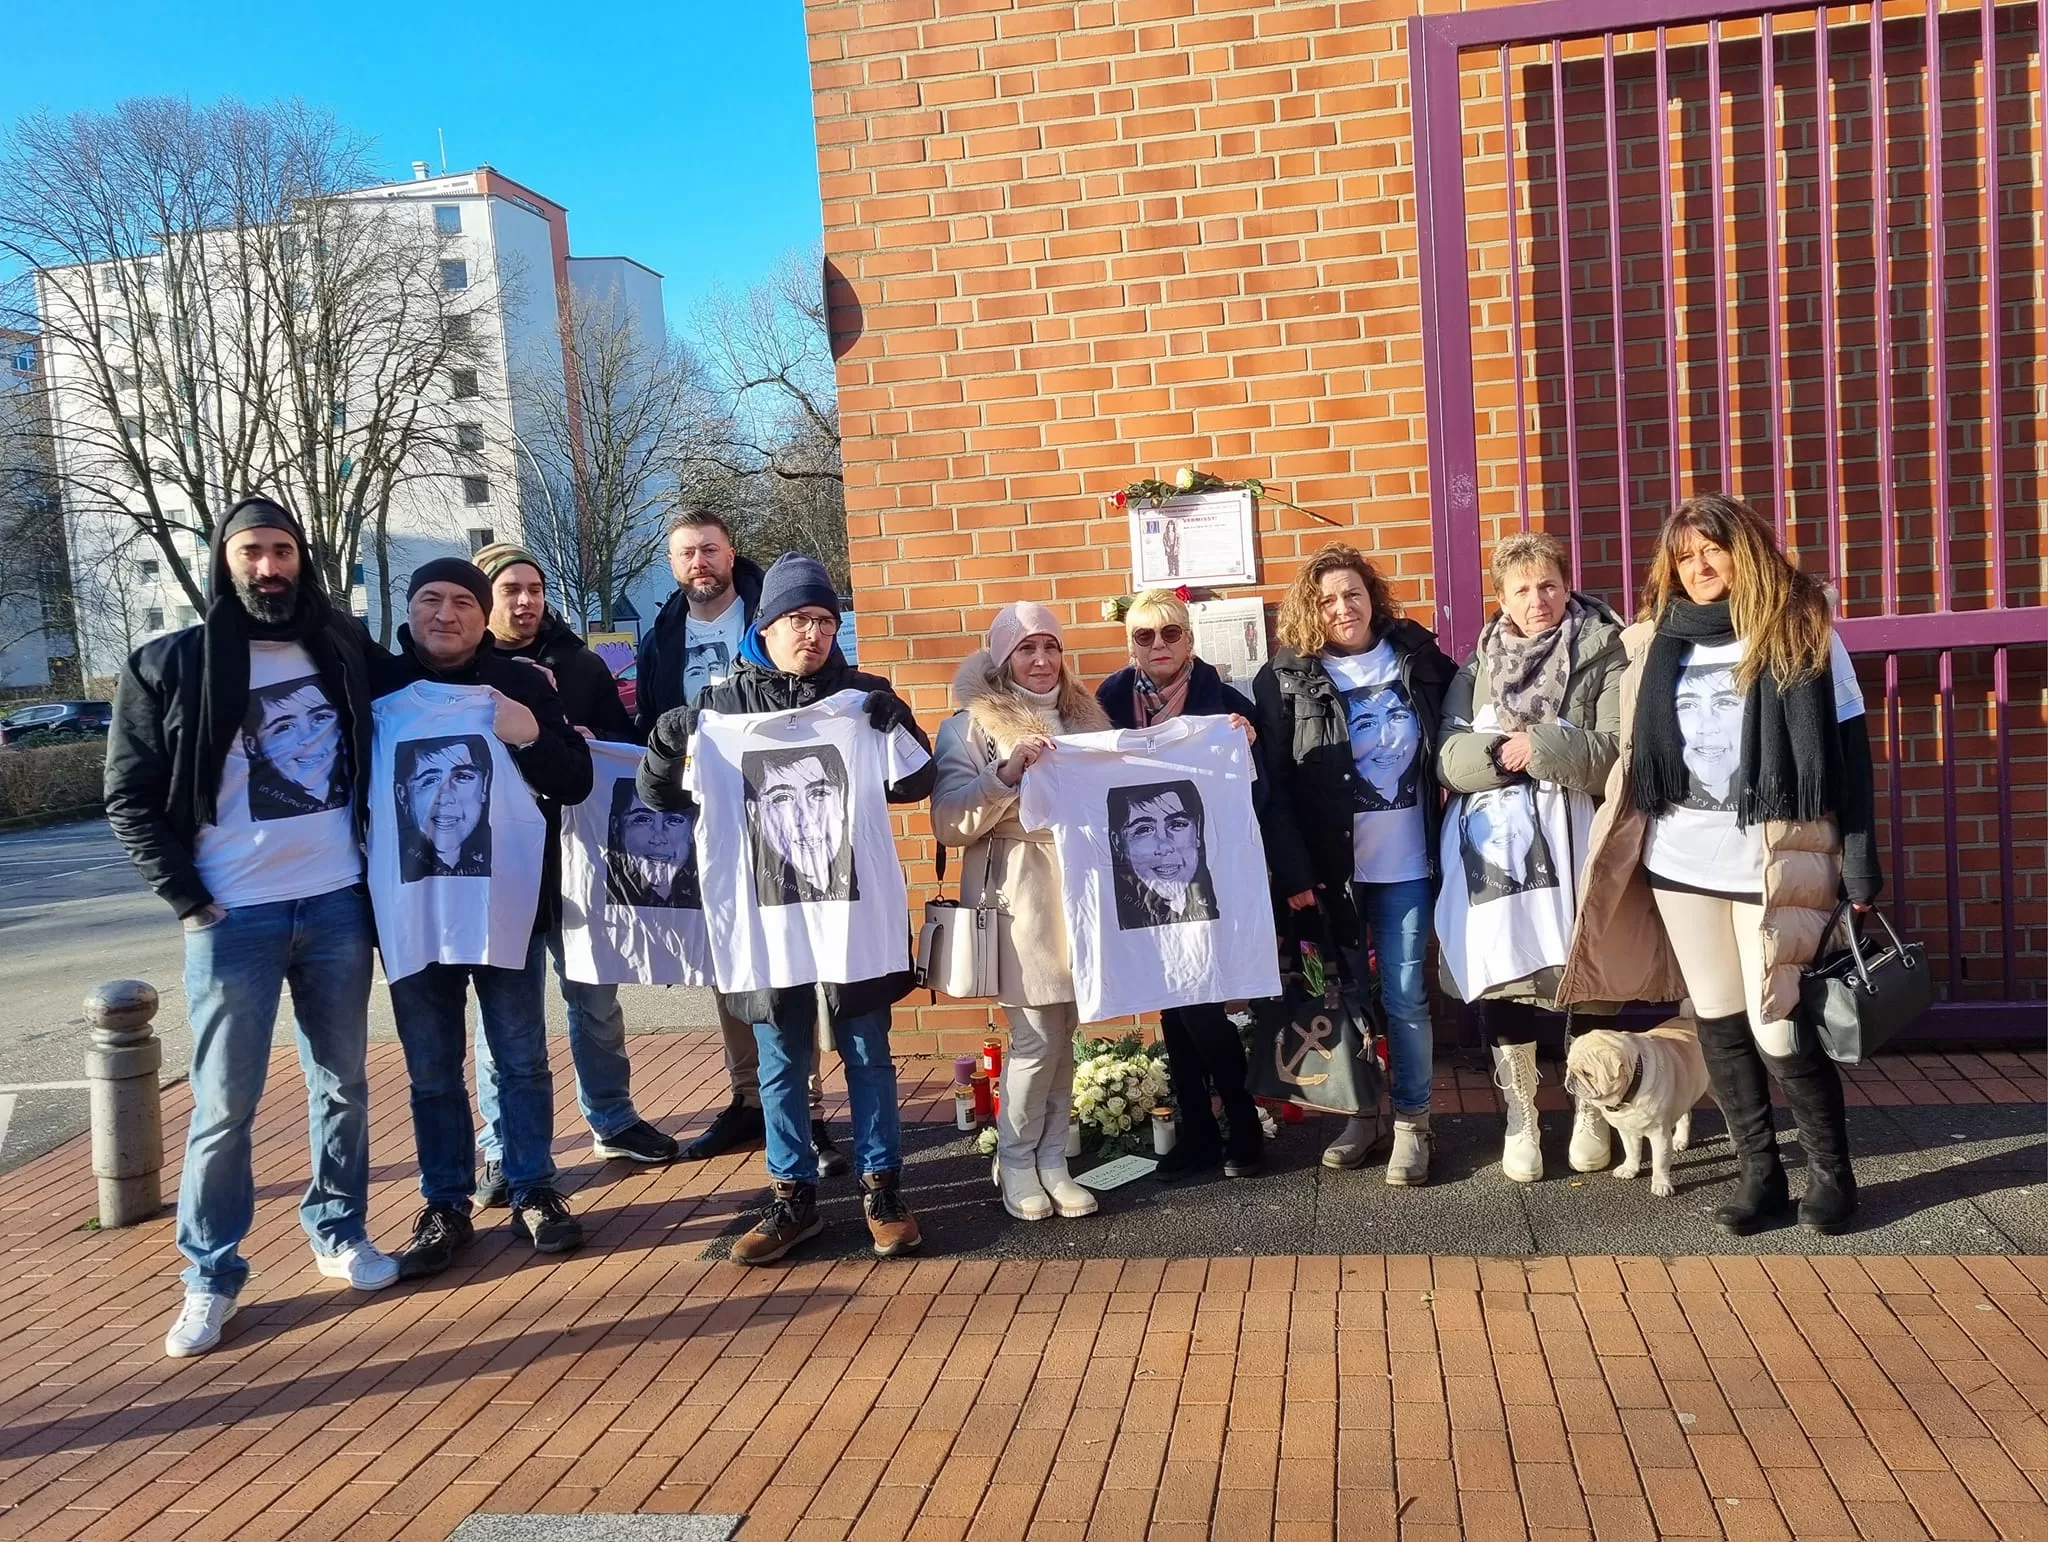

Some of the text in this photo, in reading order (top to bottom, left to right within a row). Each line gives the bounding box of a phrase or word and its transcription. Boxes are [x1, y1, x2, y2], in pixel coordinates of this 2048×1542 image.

[1354, 788, 1381, 809] emory
[773, 874, 812, 900] Memory
[1480, 874, 1513, 893] Memory
